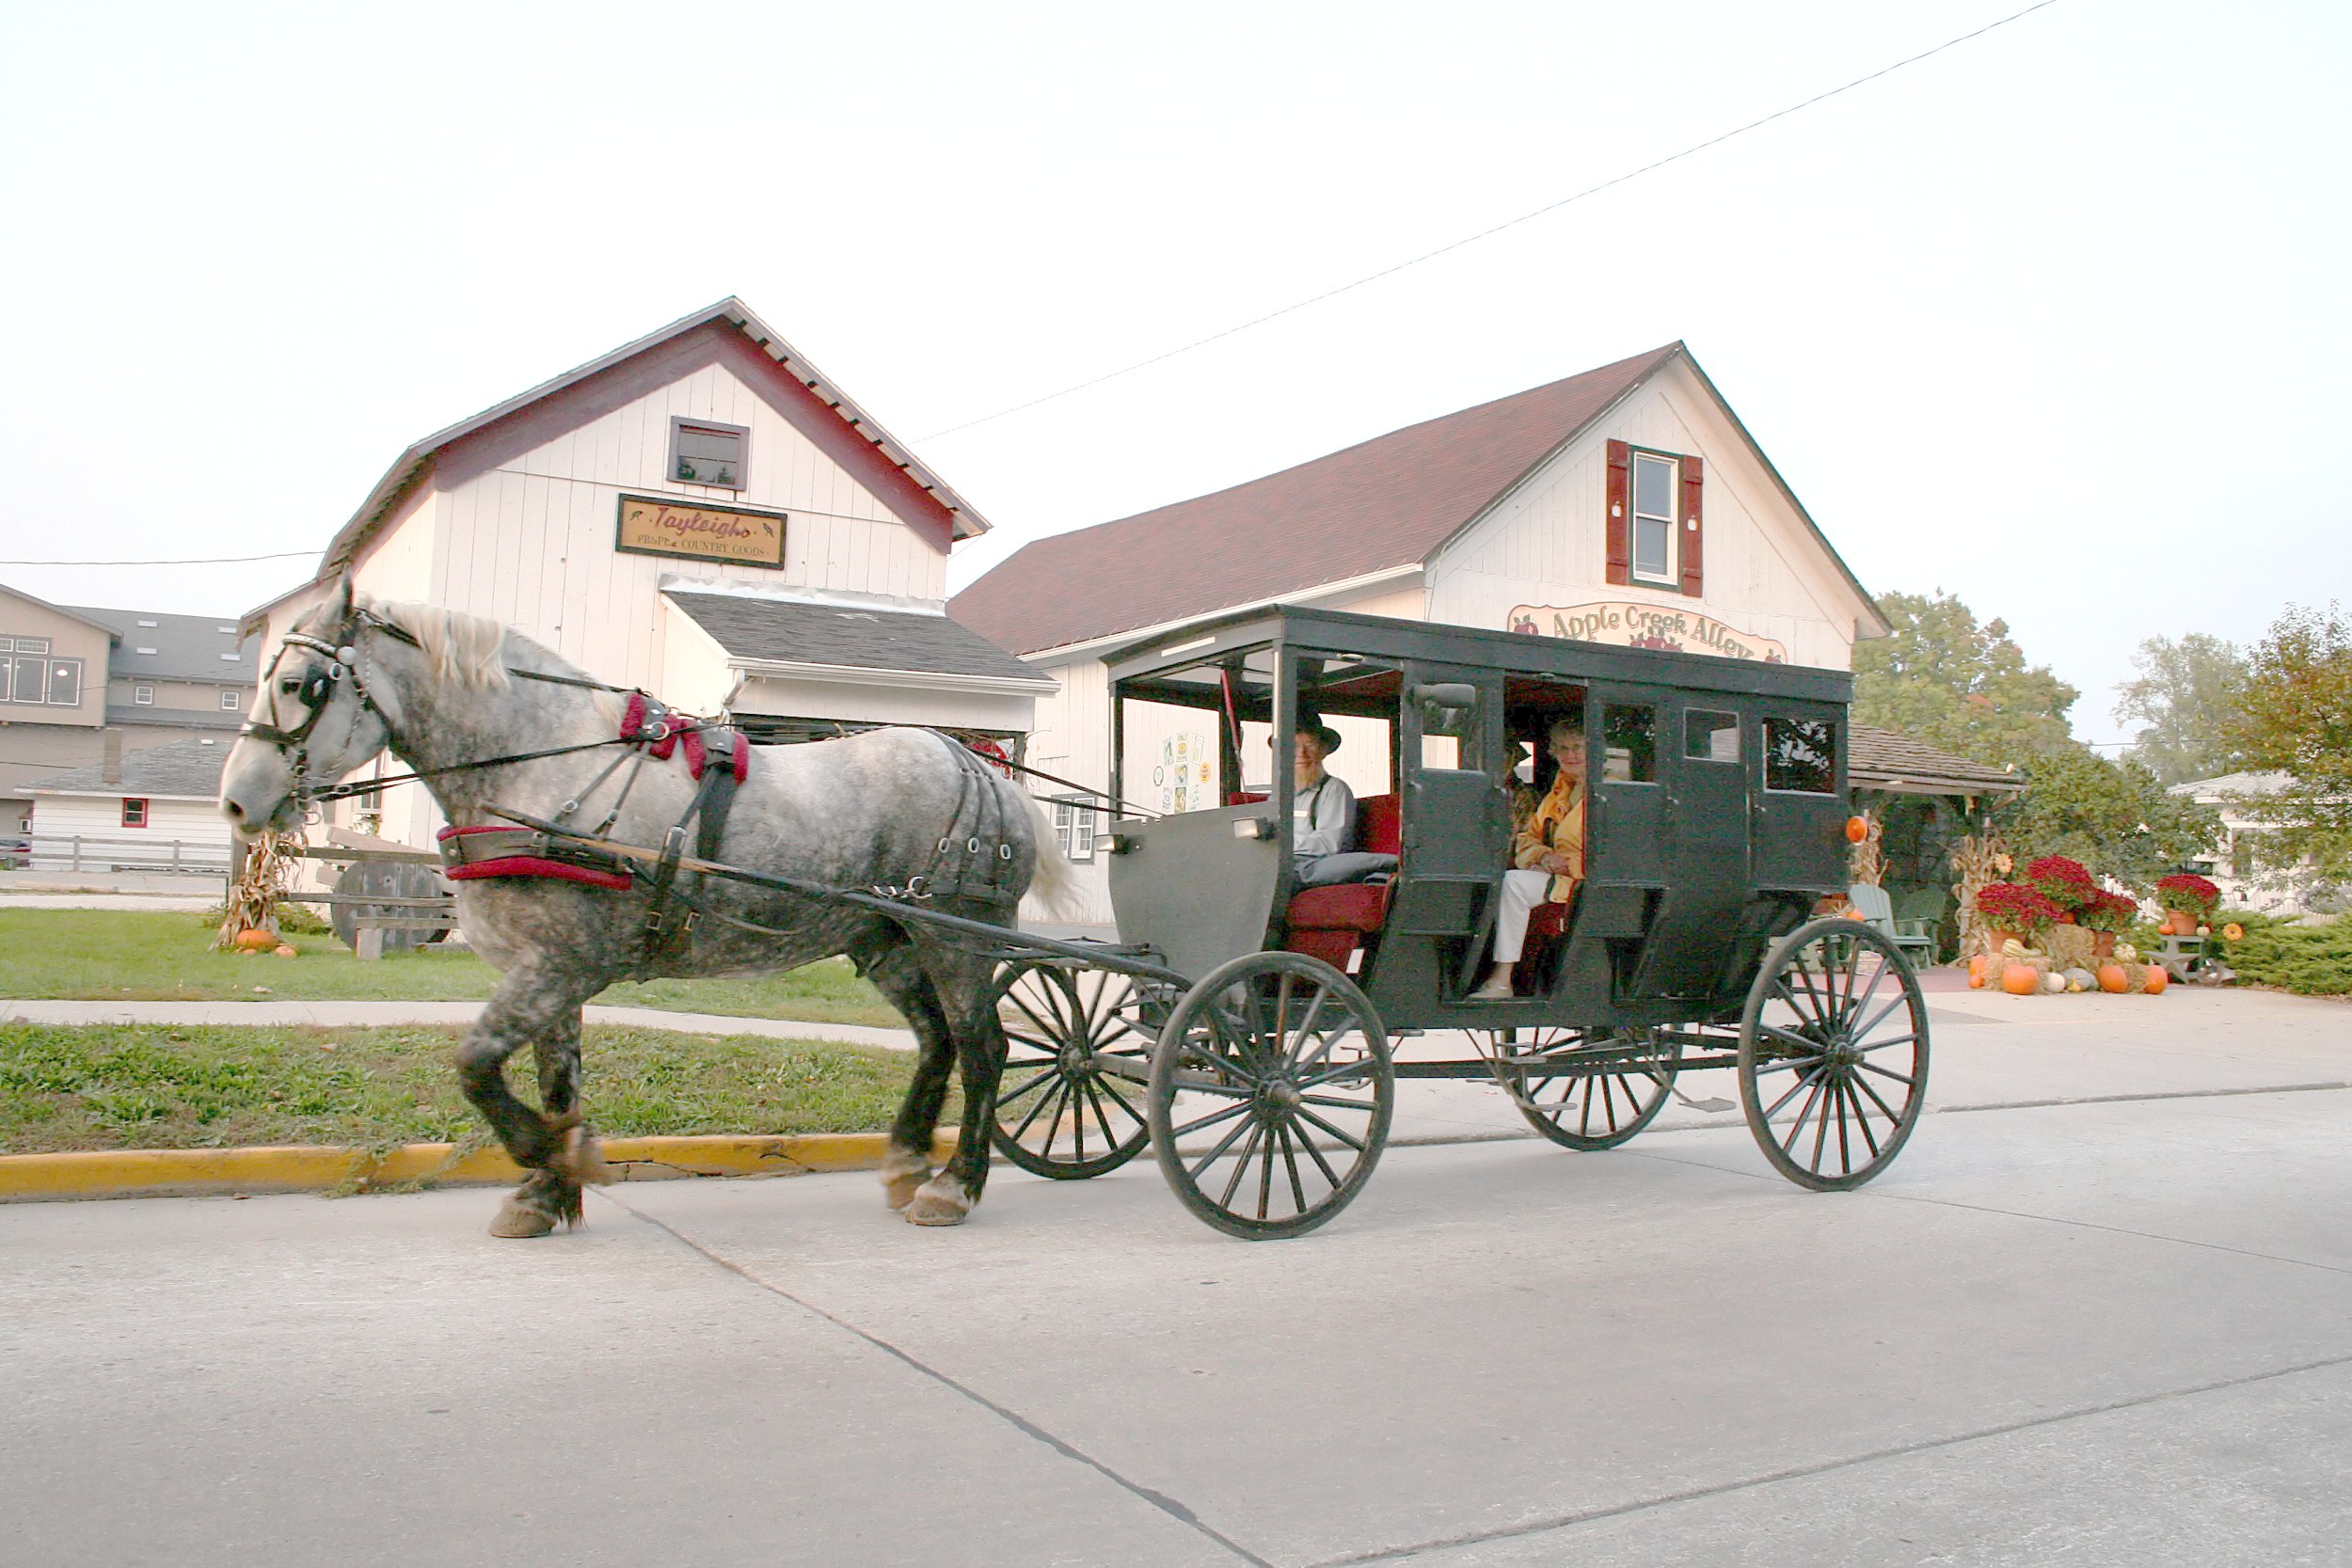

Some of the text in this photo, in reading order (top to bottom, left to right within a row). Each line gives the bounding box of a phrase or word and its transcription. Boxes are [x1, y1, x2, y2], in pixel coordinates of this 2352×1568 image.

[681, 539, 728, 553] COUNTRY
[732, 545, 765, 557] GOODS
[1553, 605, 1755, 659] Apple Creek Alley
